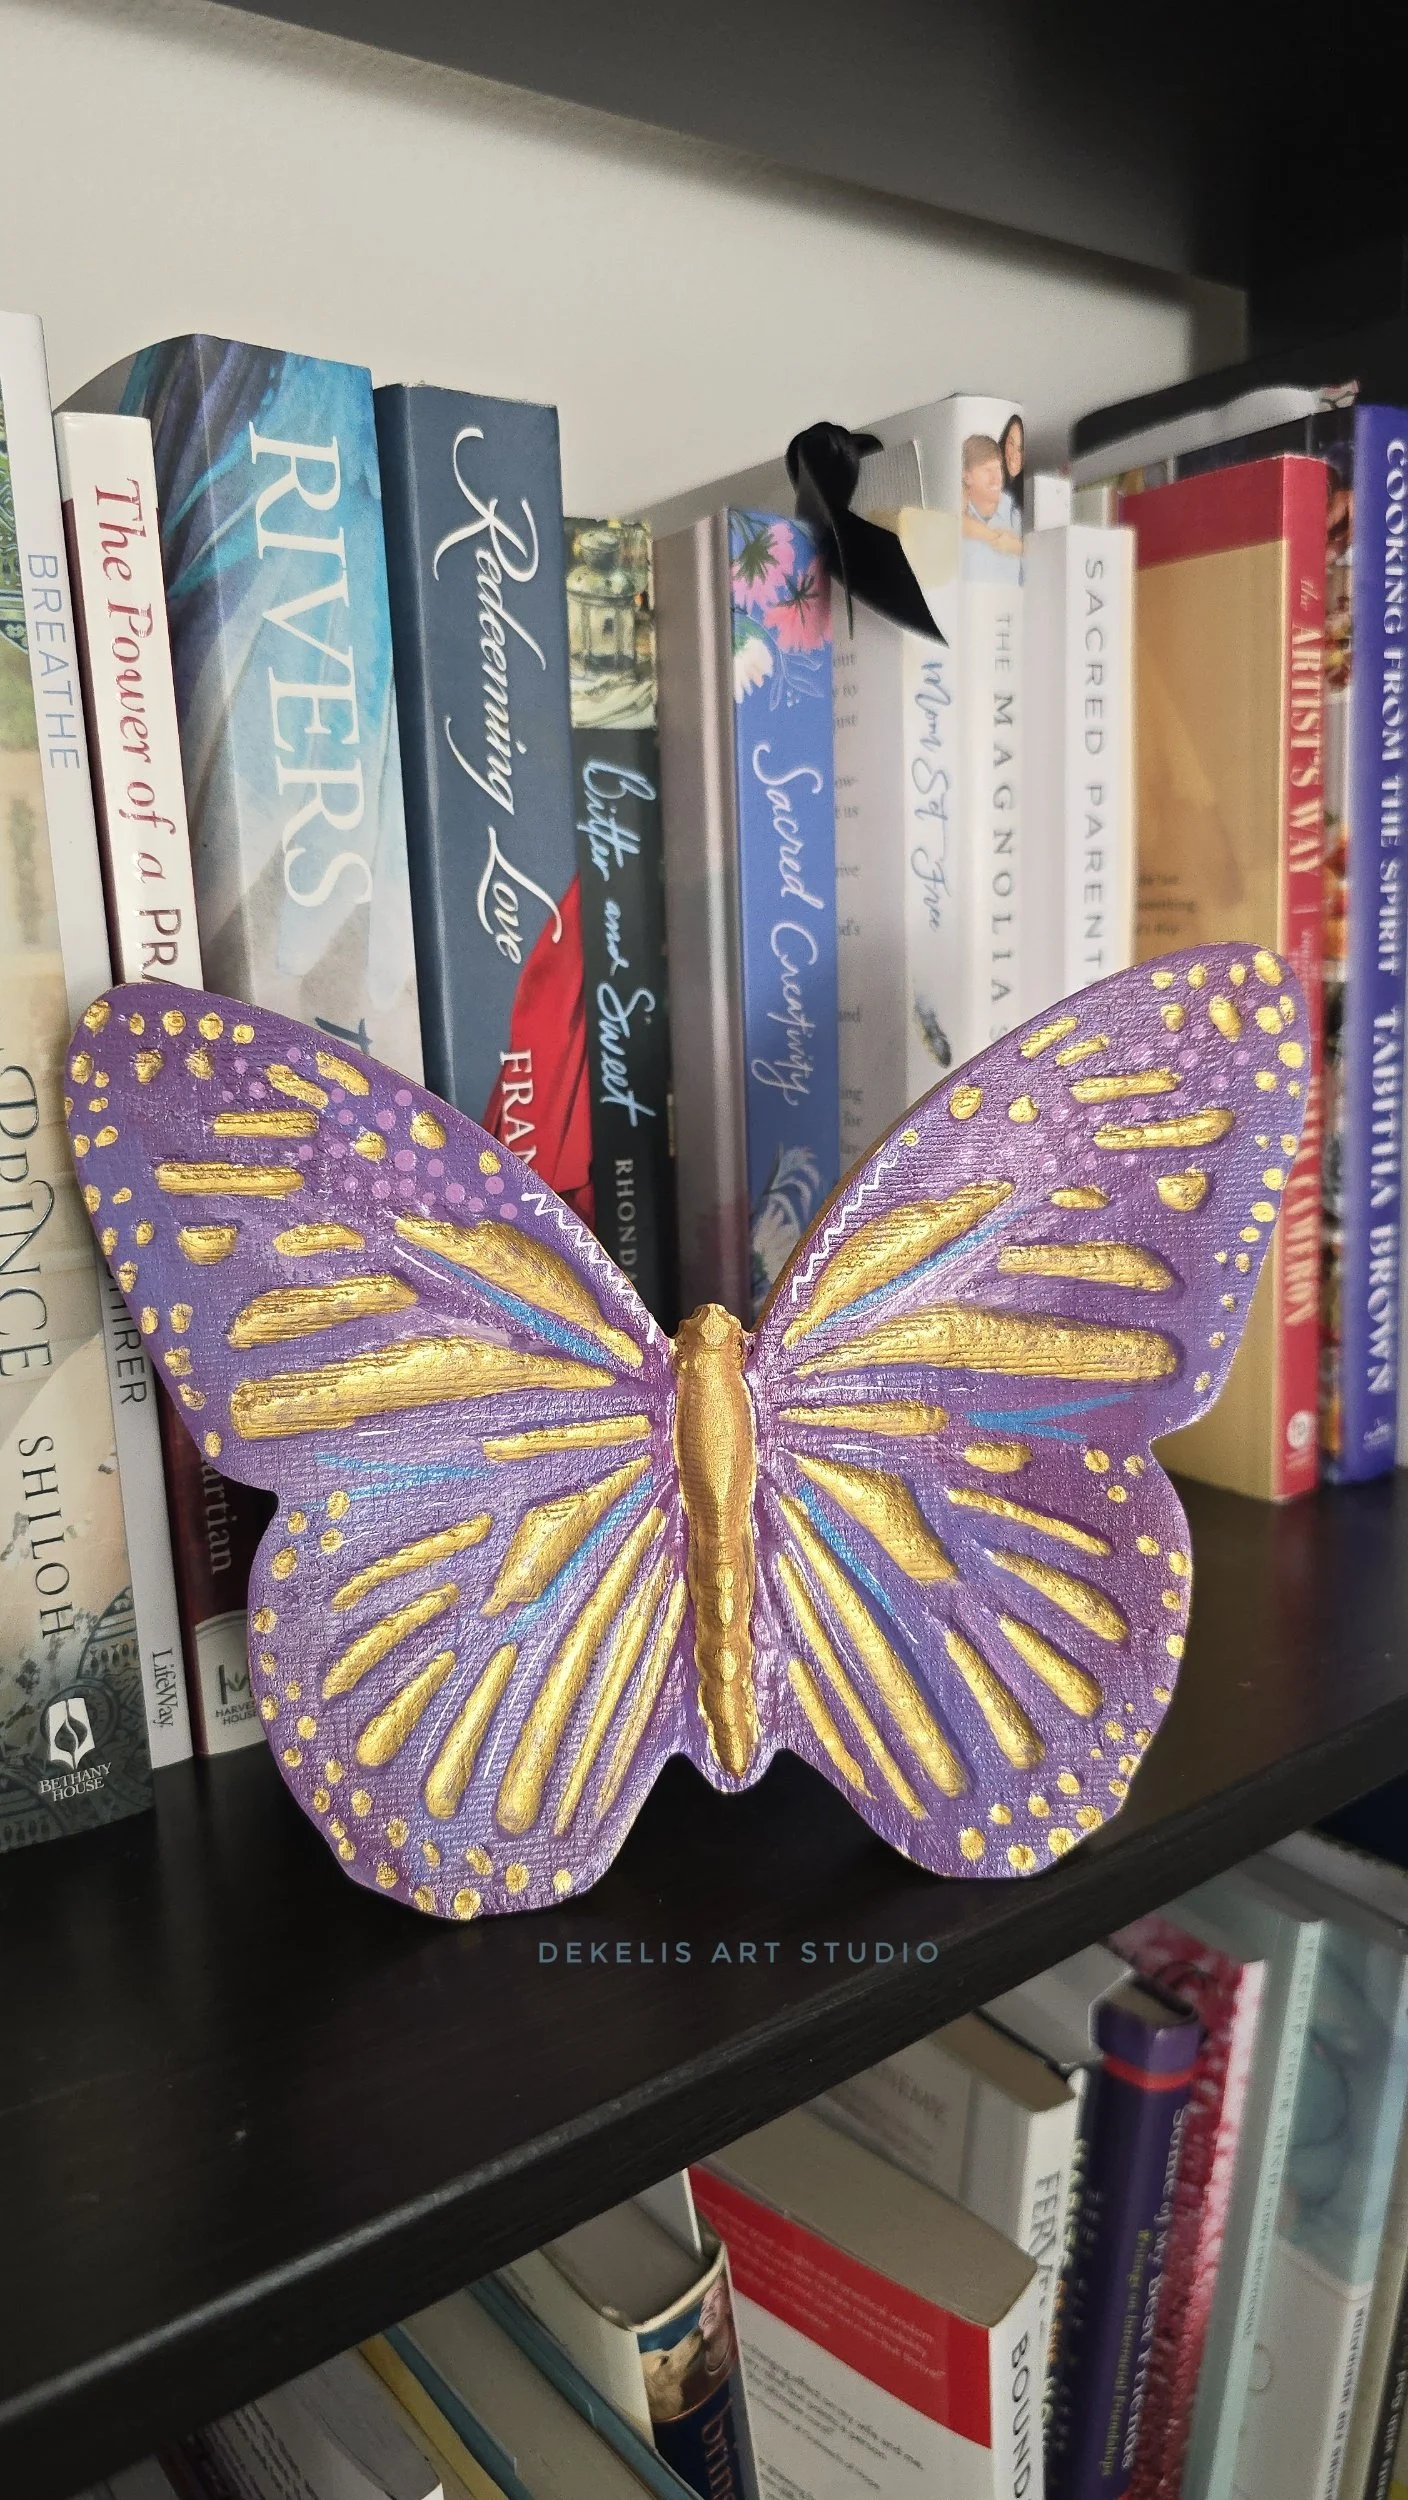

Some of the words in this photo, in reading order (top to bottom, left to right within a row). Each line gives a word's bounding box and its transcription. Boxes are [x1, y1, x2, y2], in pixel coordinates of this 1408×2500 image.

[95, 478, 147, 581] The
[1384, 438, 1408, 634] COOKING
[27, 554, 80, 769] BREATHE
[107, 602, 154, 764] Power
[248, 422, 373, 907] RIVERS
[435, 426, 549, 816] Redeeming
[994, 613, 1011, 671] THE
[1084, 557, 1105, 755] SACRED
[1288, 623, 1324, 789] ARTIST'S
[1381, 643, 1406, 762] FROM
[119, 781, 176, 836] of
[134, 849, 166, 885] a
[578, 757, 656, 882] Bitter
[752, 741, 823, 916] Sacred
[991, 693, 1014, 1003] MAGNOLIA
[1083, 783, 1104, 986] PARENT
[1286, 798, 1324, 876] WAY
[1380, 773, 1402, 849] THE
[476, 827, 563, 966] Love
[603, 896, 630, 976] and
[1375, 857, 1402, 976] SPIRIT
[597, 982, 657, 1127] Sweet
[750, 920, 819, 1106] Creativity
[1371, 1007, 1401, 1208] TABITHA
[106, 1264, 148, 1405] IRER
[1366, 1223, 1397, 1395] BROWN
[18, 1435, 76, 1640] SHILOH
[40, 1761, 112, 1794] BETHANY
[52, 1776, 105, 1802] HOUSE
[1011, 2329, 1031, 2500] BOUND
